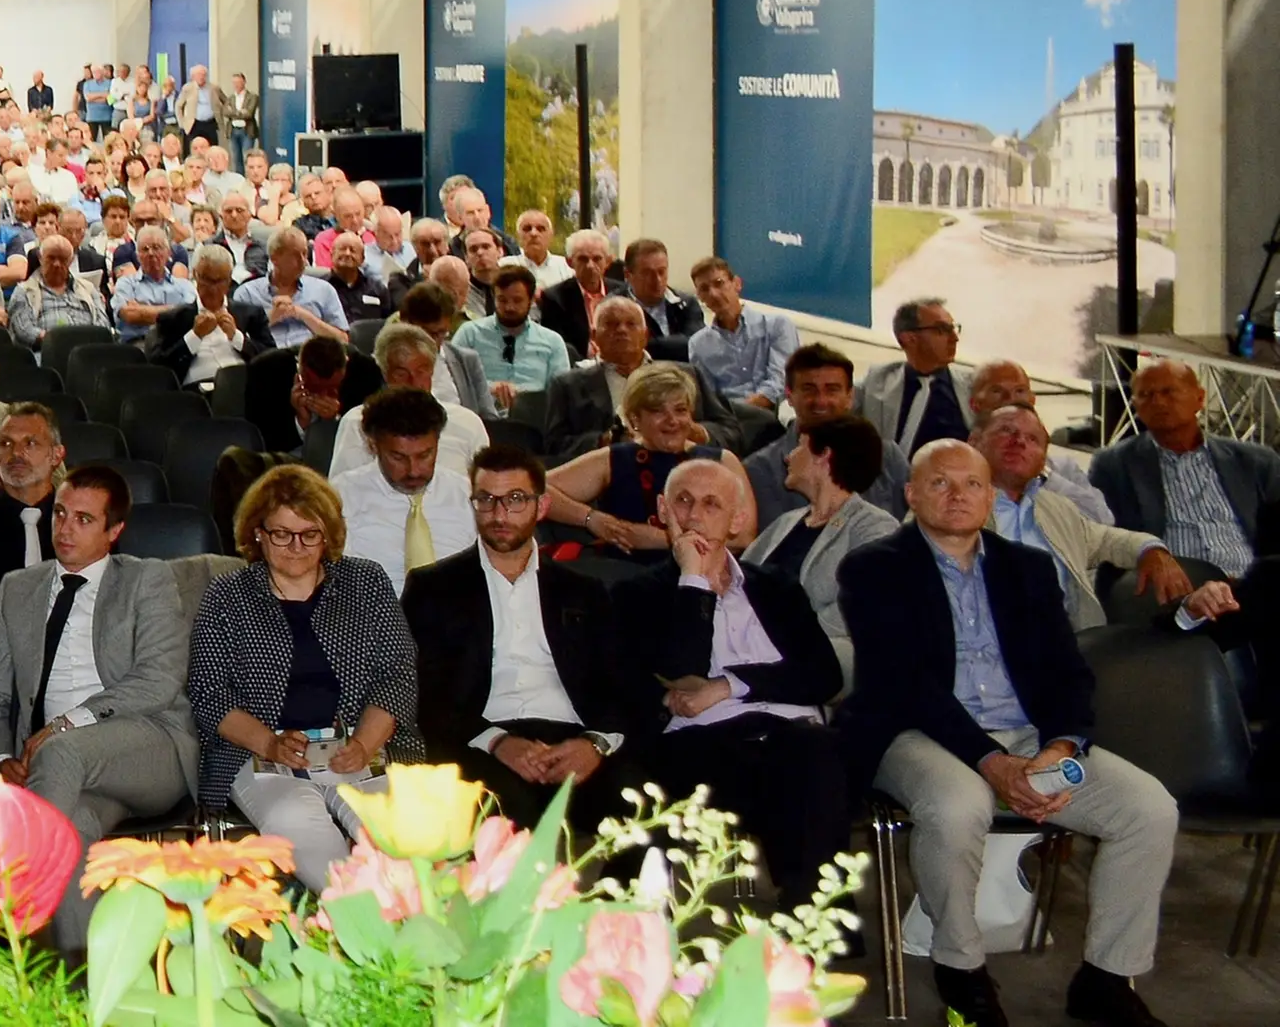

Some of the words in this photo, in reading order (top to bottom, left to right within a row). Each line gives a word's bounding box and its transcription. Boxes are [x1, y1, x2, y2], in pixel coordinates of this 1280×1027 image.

[739, 77, 772, 96] SOSTIENE
[773, 78, 783, 96] LE
[783, 68, 840, 99] COMUNITÀ
